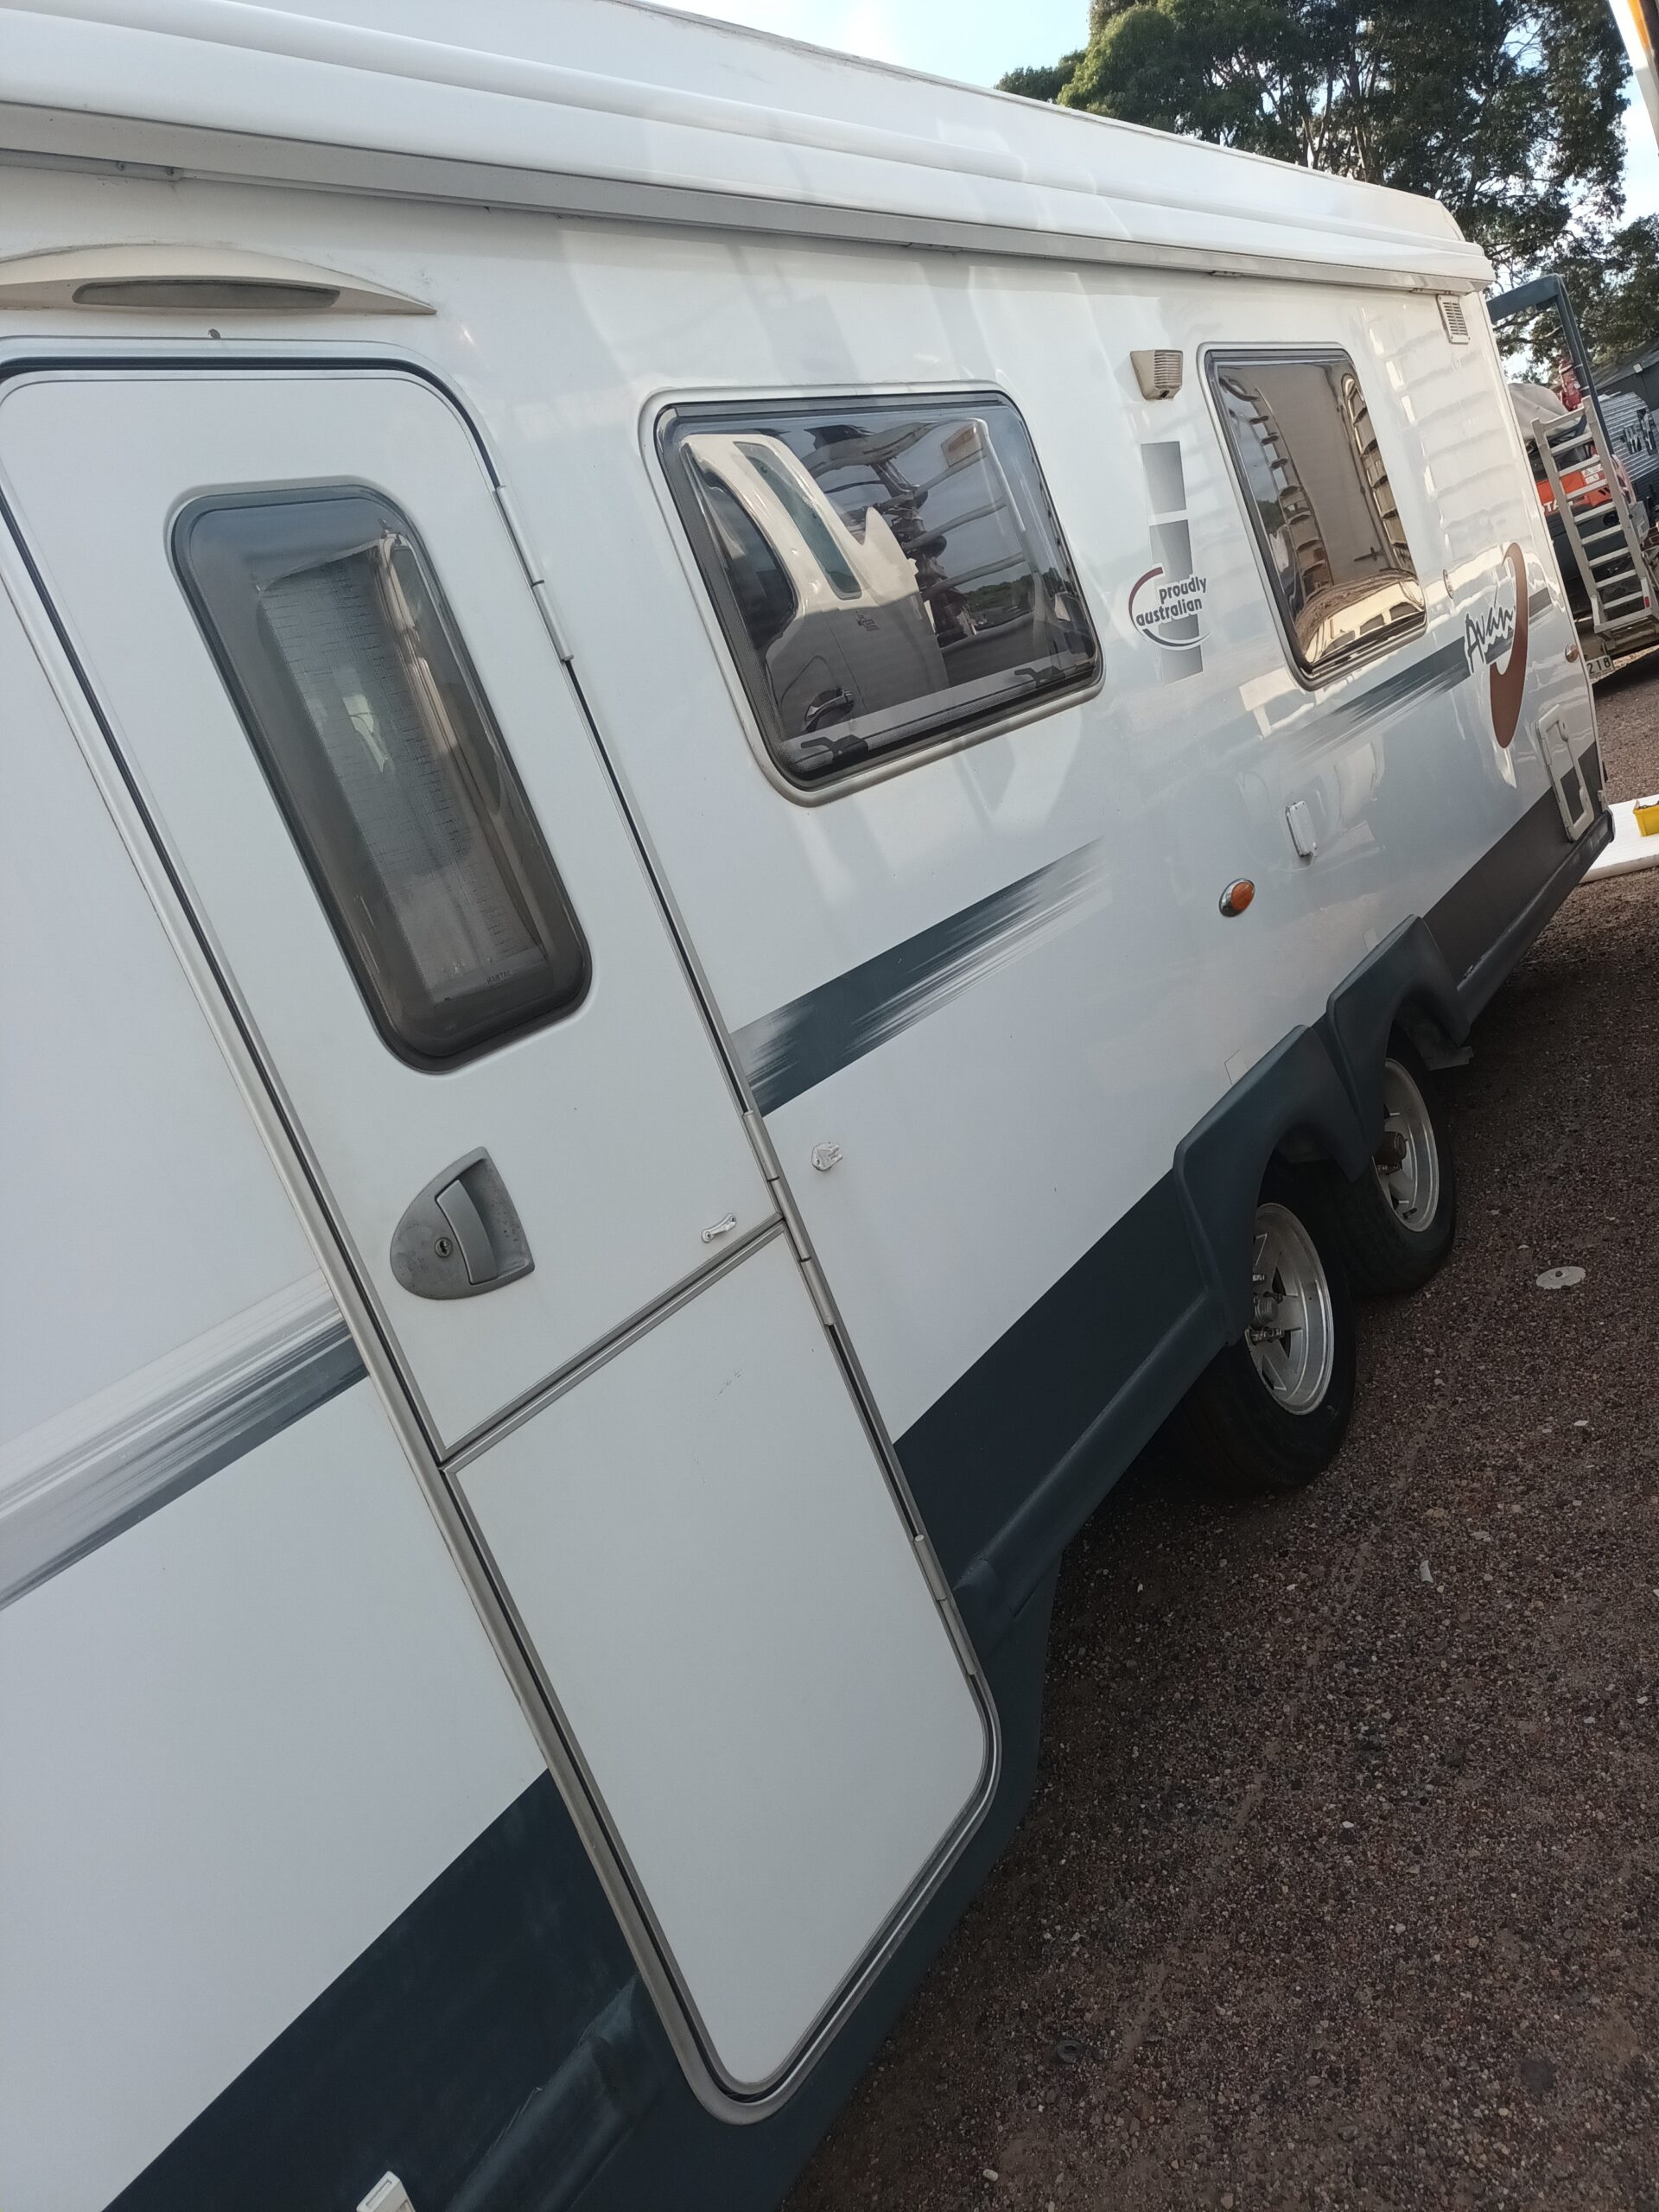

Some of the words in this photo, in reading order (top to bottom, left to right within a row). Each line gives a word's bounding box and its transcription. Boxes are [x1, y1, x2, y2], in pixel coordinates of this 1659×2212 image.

[1159, 577, 1207, 604] proudly
[1135, 598, 1203, 626] australian
[1586, 657, 1611, 674] 218
